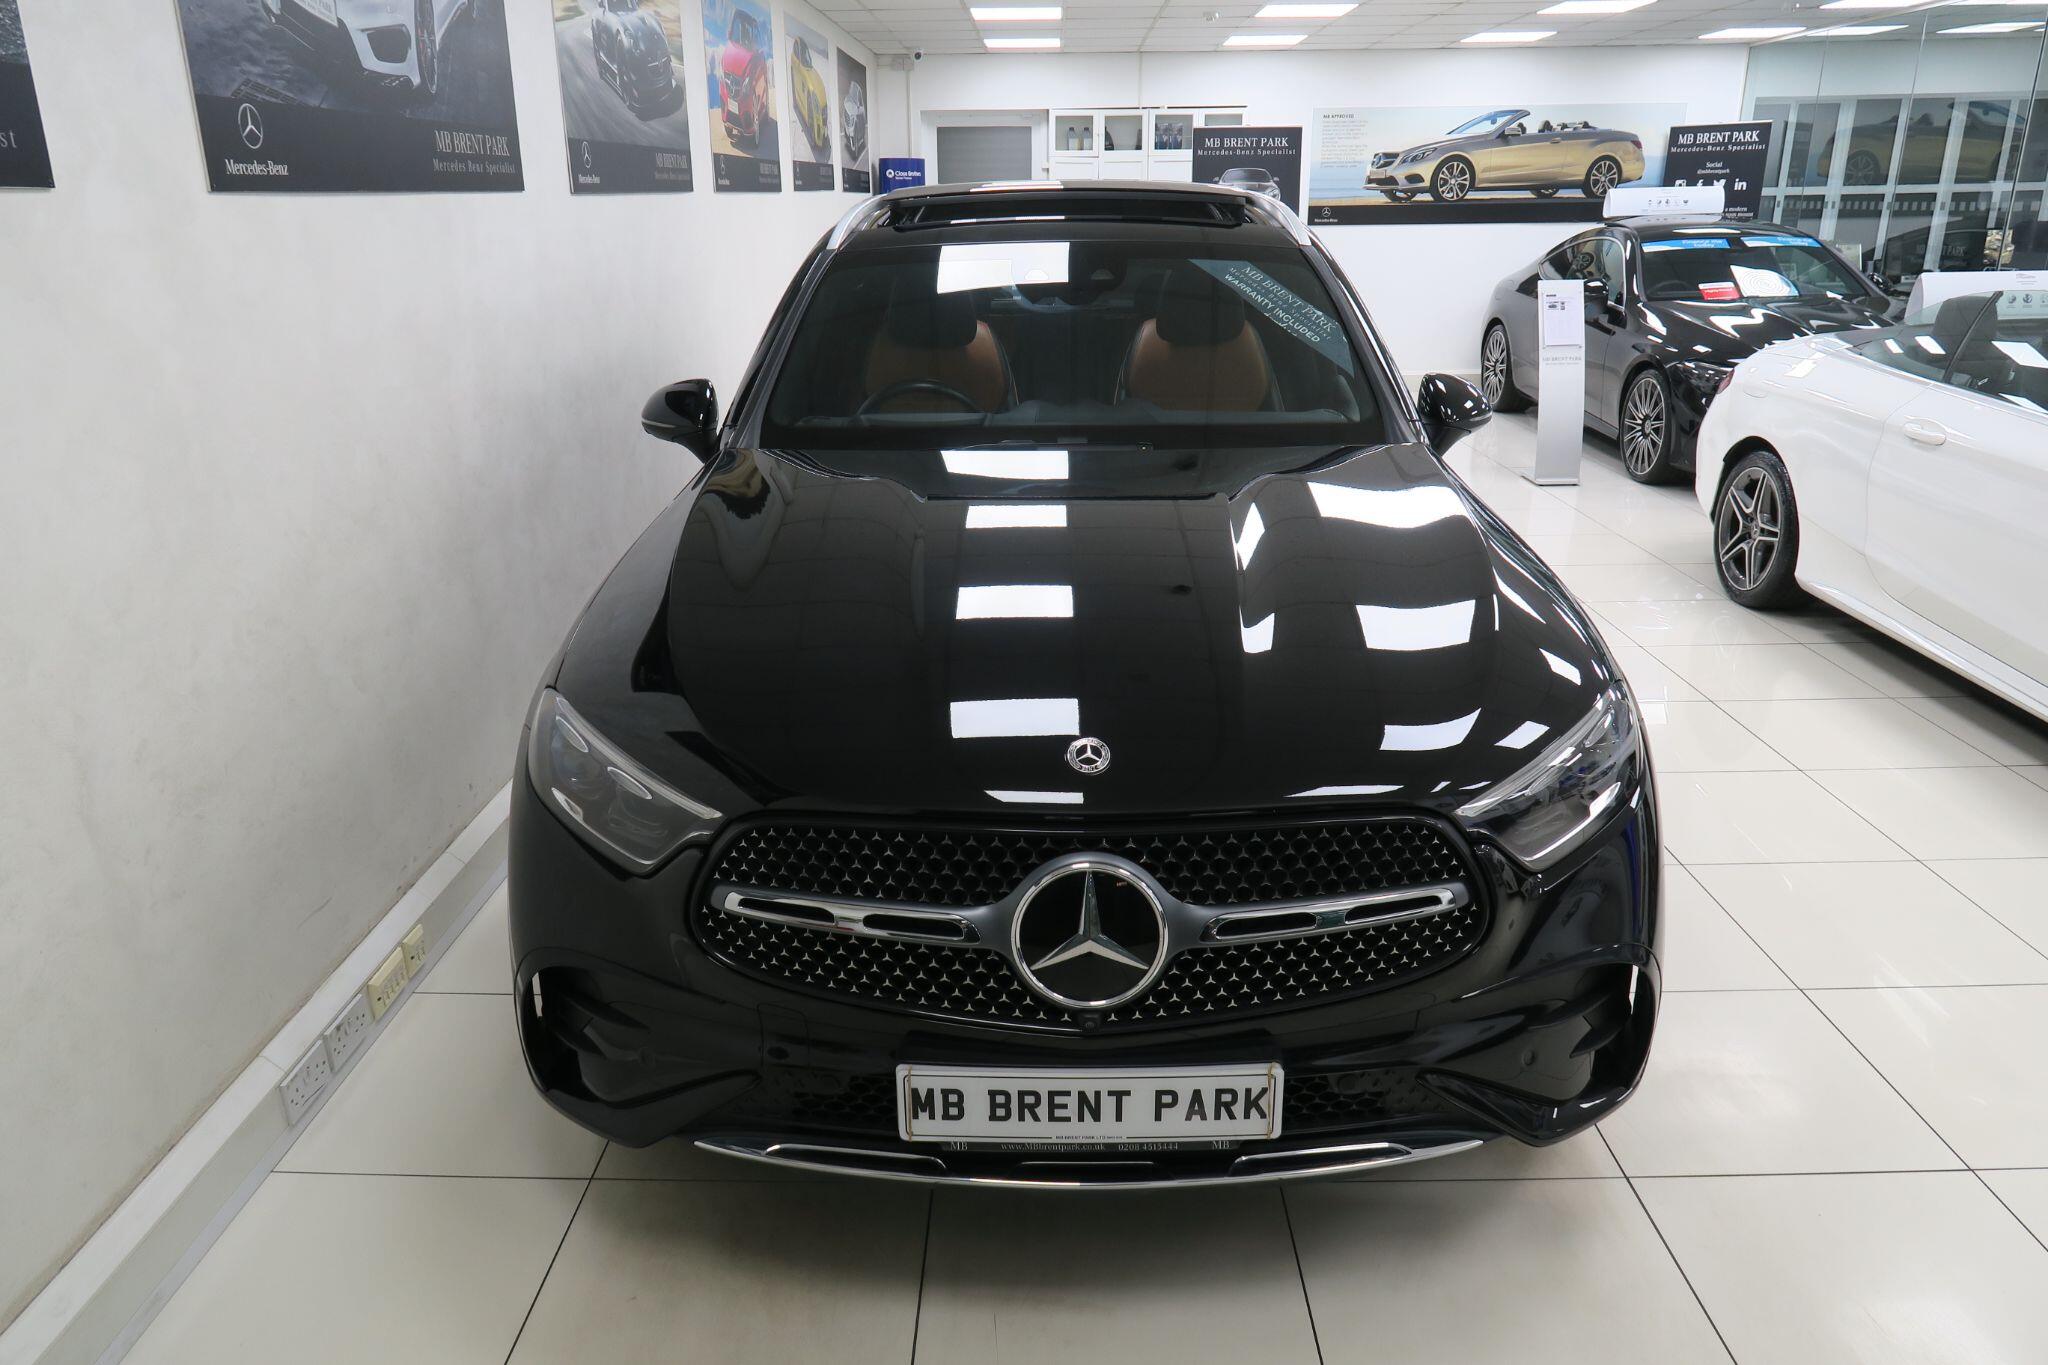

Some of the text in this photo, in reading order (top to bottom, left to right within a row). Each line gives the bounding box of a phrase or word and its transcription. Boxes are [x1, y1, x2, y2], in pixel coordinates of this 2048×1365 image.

[434, 130, 510, 156] MB BRENT PARK
[1204, 137, 1289, 148] MB BRENT PARK
[1678, 130, 1760, 145] MB BRENT PARK
[1198, 148, 1296, 156] Mercedes-Benz Specialist
[1671, 144, 1766, 153] Mercedes-Benz Specialist
[224, 158, 289, 176] Mercedes-Benz
[433, 158, 466, 172] Mercedes
[485, 161, 515, 175] Specialist
[1734, 178, 1747, 191] in
[1241, 266, 1336, 333] MB BRENT PARK
[1224, 273, 1320, 343] WARRANTY INCLUDED
[911, 1087, 1269, 1123] MB BRENT PARK
[950, 1141, 968, 1151] MB
[1211, 1140, 1230, 1150] MB
